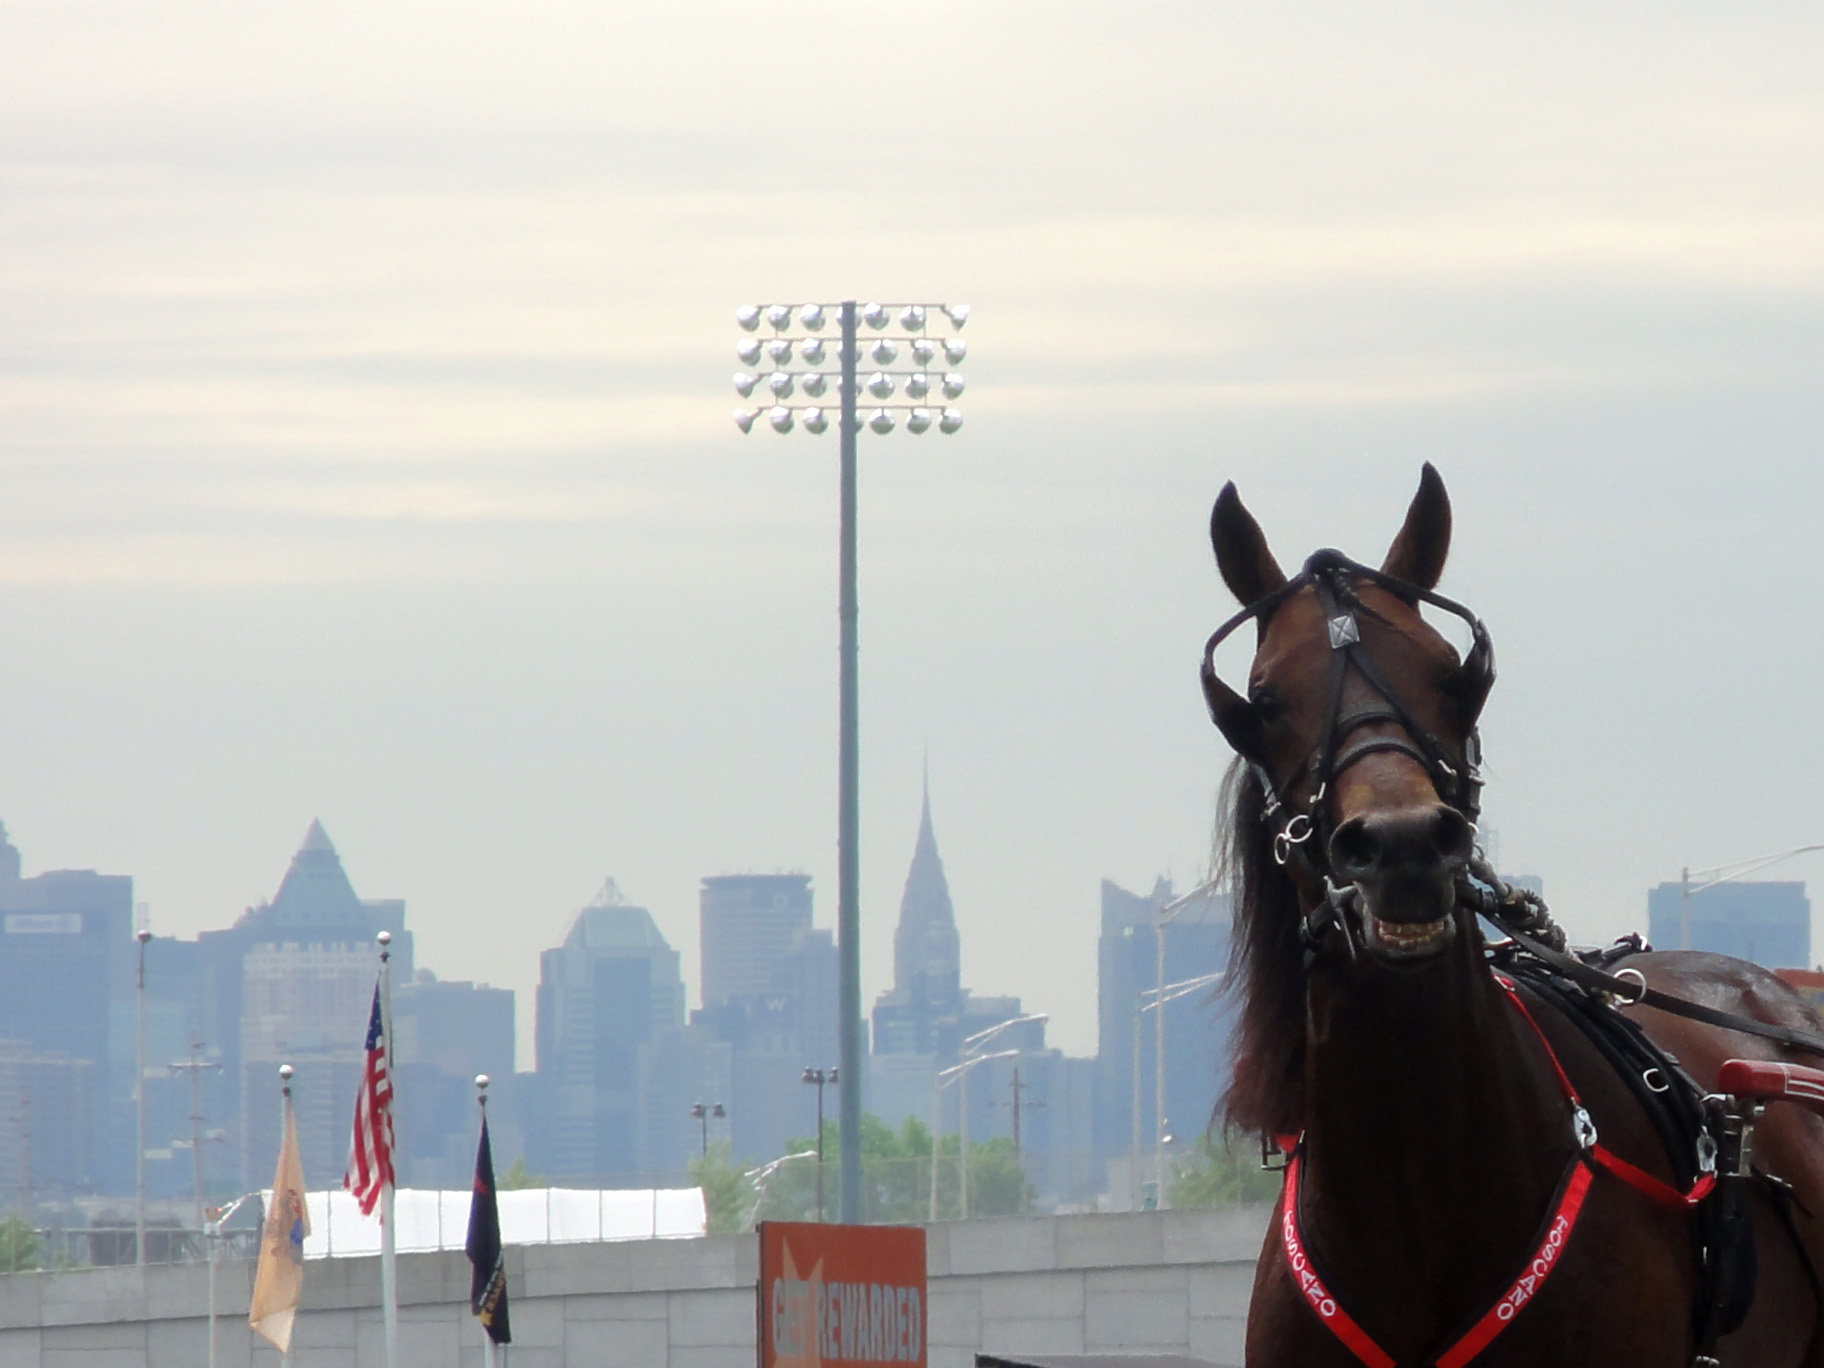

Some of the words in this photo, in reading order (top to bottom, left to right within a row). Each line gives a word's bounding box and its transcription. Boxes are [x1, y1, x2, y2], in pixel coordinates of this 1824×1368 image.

[1283, 1209, 1337, 1317] TOSCANO
[1497, 1214, 1568, 1320] TOSCANO
[815, 1279, 921, 1362] REWARDED
